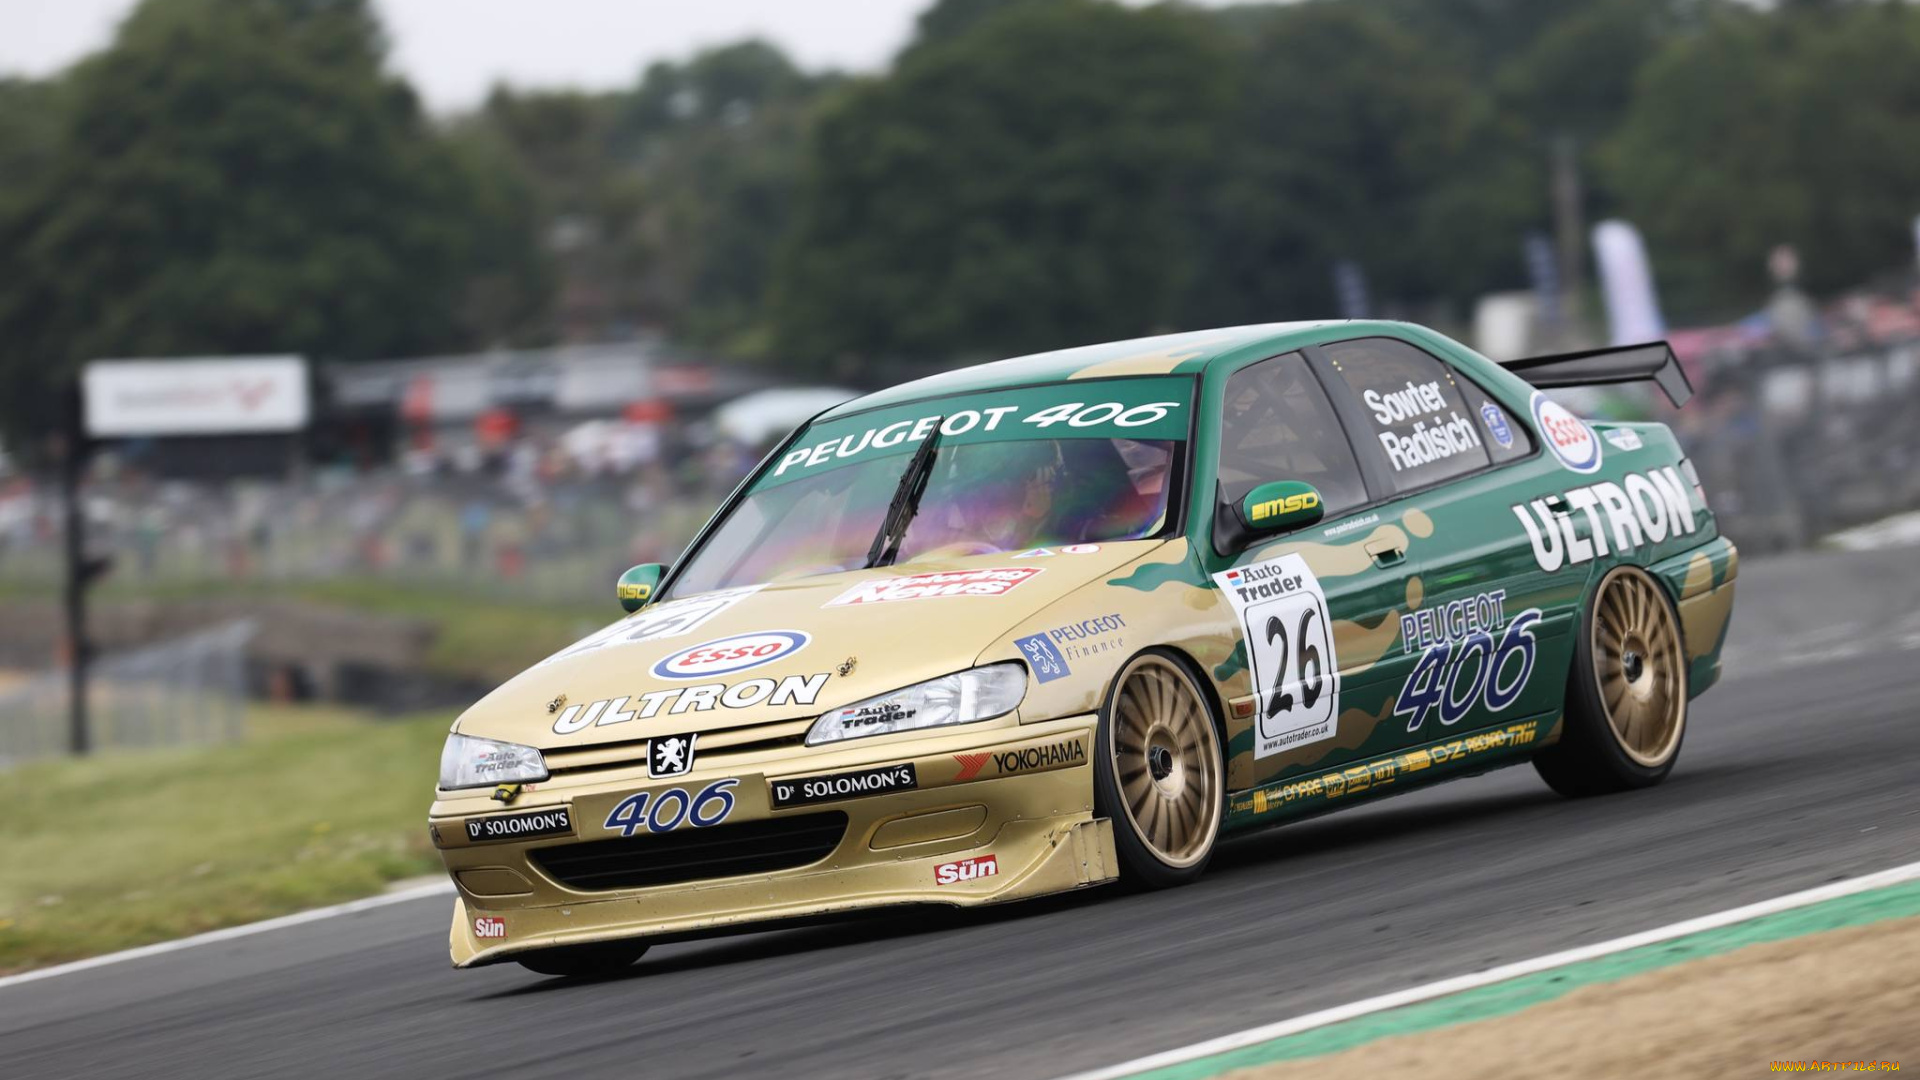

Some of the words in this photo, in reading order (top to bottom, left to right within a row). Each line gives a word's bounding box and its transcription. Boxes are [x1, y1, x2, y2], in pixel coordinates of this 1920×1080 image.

[1363, 380, 1447, 426] Sowter
[774, 406, 1018, 476] PEUGEOT
[1022, 402, 1181, 428] 406
[1377, 410, 1480, 471] Radisich
[1512, 465, 1696, 574] ULTRON
[1236, 574, 1303, 603] Trader
[1240, 562, 1283, 584] Auto
[1050, 613, 1126, 644] PEUGEOT
[1401, 588, 1506, 654] PEUGEOT
[1066, 636, 1124, 660] Finance
[1264, 607, 1322, 720] 26
[1393, 607, 1543, 732] 406
[552, 672, 832, 735] ULTRON
[841, 707, 917, 729] Trader
[856, 703, 902, 717] Auto
[1263, 723, 1329, 750] www.autotrader.co.uk
[475, 759, 523, 773] Trader
[488, 752, 515, 760] Auto
[993, 738, 1084, 773] YOKOHAMA
[803, 768, 911, 798] SOLOMON'S
[603, 777, 741, 837] 406
[485, 811, 568, 836] SOLOMON'S
